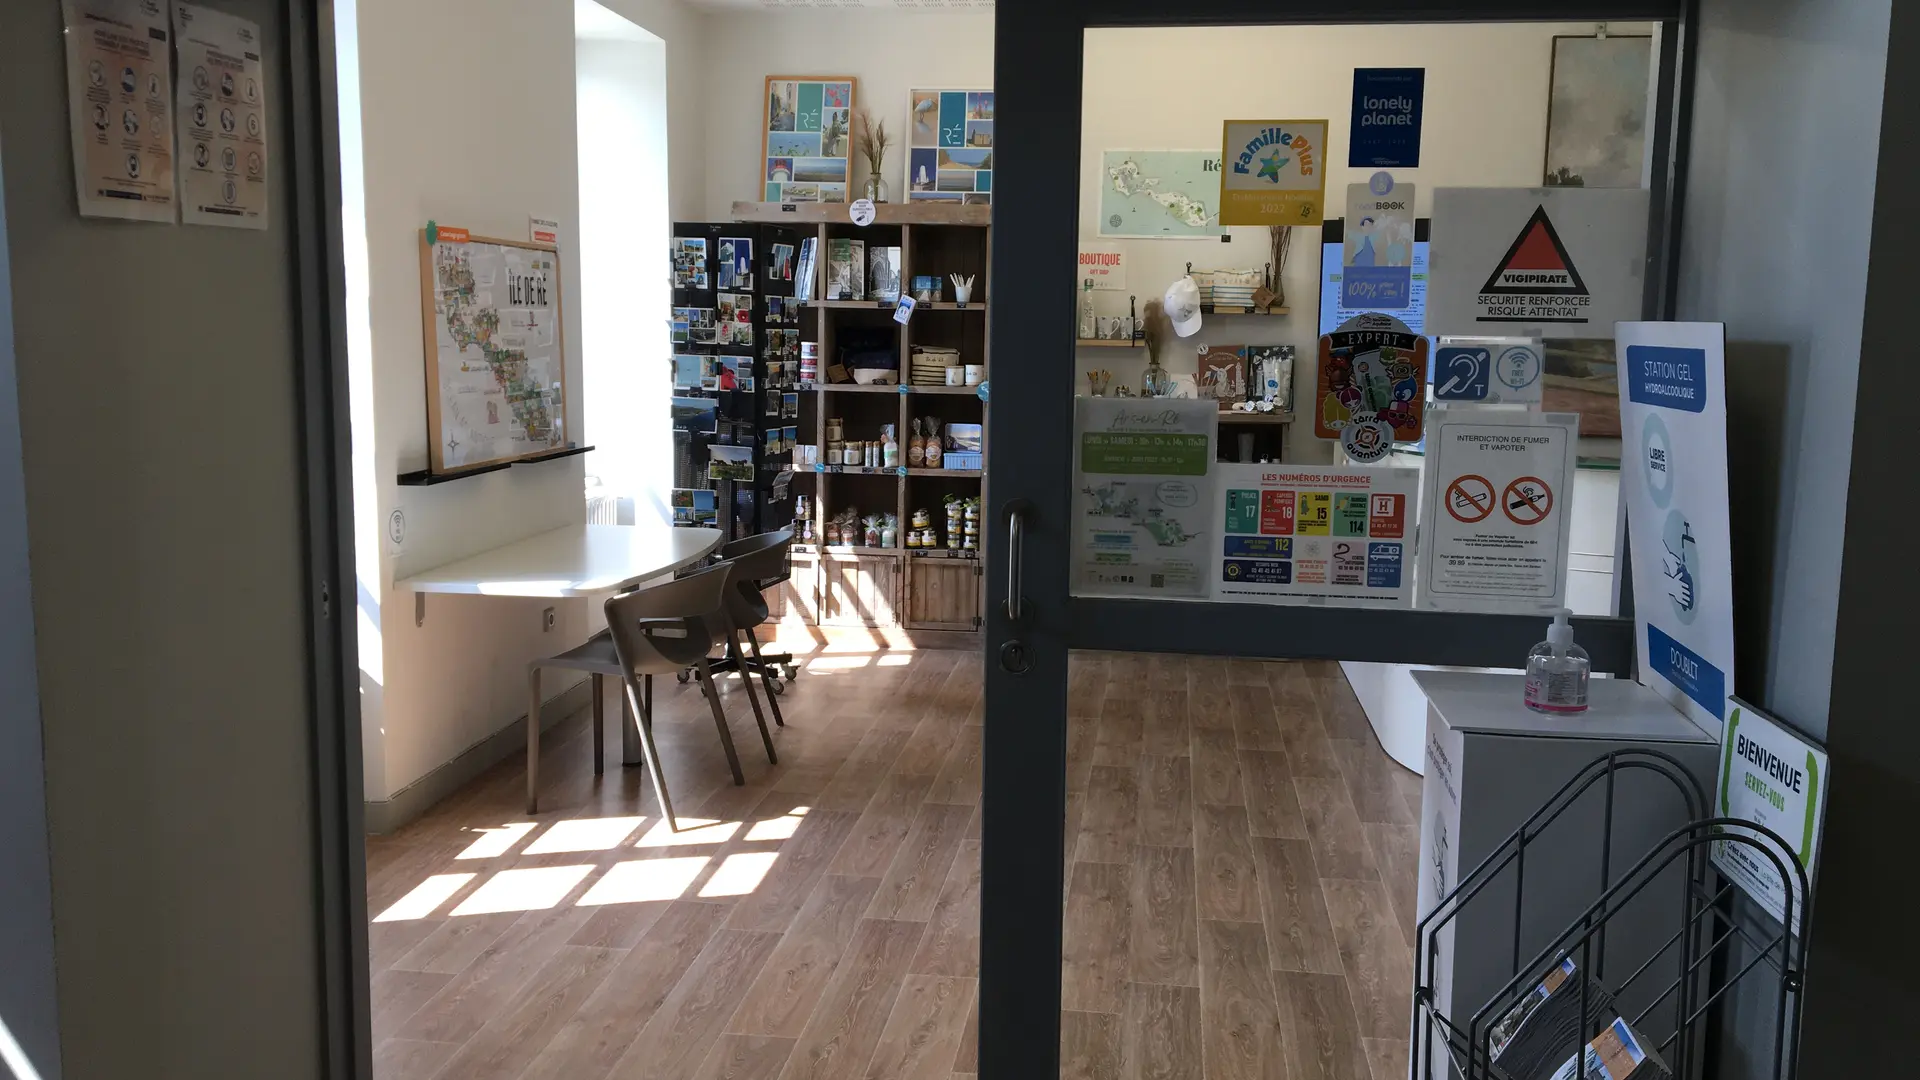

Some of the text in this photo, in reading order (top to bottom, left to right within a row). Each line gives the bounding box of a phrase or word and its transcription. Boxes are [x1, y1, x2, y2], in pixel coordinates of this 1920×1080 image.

[1363, 95, 1412, 113] lonely
[1361, 111, 1413, 127] planet
[1234, 127, 1313, 176] Famille Plus
[1079, 253, 1121, 267] BOUTIQUE
[1503, 274, 1568, 284] VIGIPIRATE
[524, 275, 535, 306] DE
[1349, 282, 1377, 300] 100%
[1477, 295, 1591, 306] SECURITE RENFORCEE
[1487, 306, 1579, 317] RISQUE ATTENTAT
[1348, 332, 1400, 346] EXPERT
[1644, 360, 1694, 382] STATION GEL
[1475, 385, 1485, 396] T
[1645, 382, 1695, 400] HYDROALCOOLIQUE
[1457, 435, 1509, 444] INTERDICTION
[1511, 436, 1522, 444] DE
[1491, 444, 1526, 452] VAPOTER
[1649, 446, 1666, 462] LIBRE
[1651, 460, 1666, 473] SERVICE
[1262, 473, 1371, 484] LES NUMÉROS D'URGENCE
[1245, 505, 1256, 519] 17
[1282, 507, 1293, 519] 18
[1380, 501, 1389, 511] H
[1317, 507, 1328, 520] 15
[1349, 520, 1364, 534] 114
[1275, 538, 1289, 552] 112
[1670, 646, 1699, 681] DOUBLET
[1738, 733, 1802, 794] BIENVENUE
[1744, 771, 1785, 813] SERVEZ-VOUS
